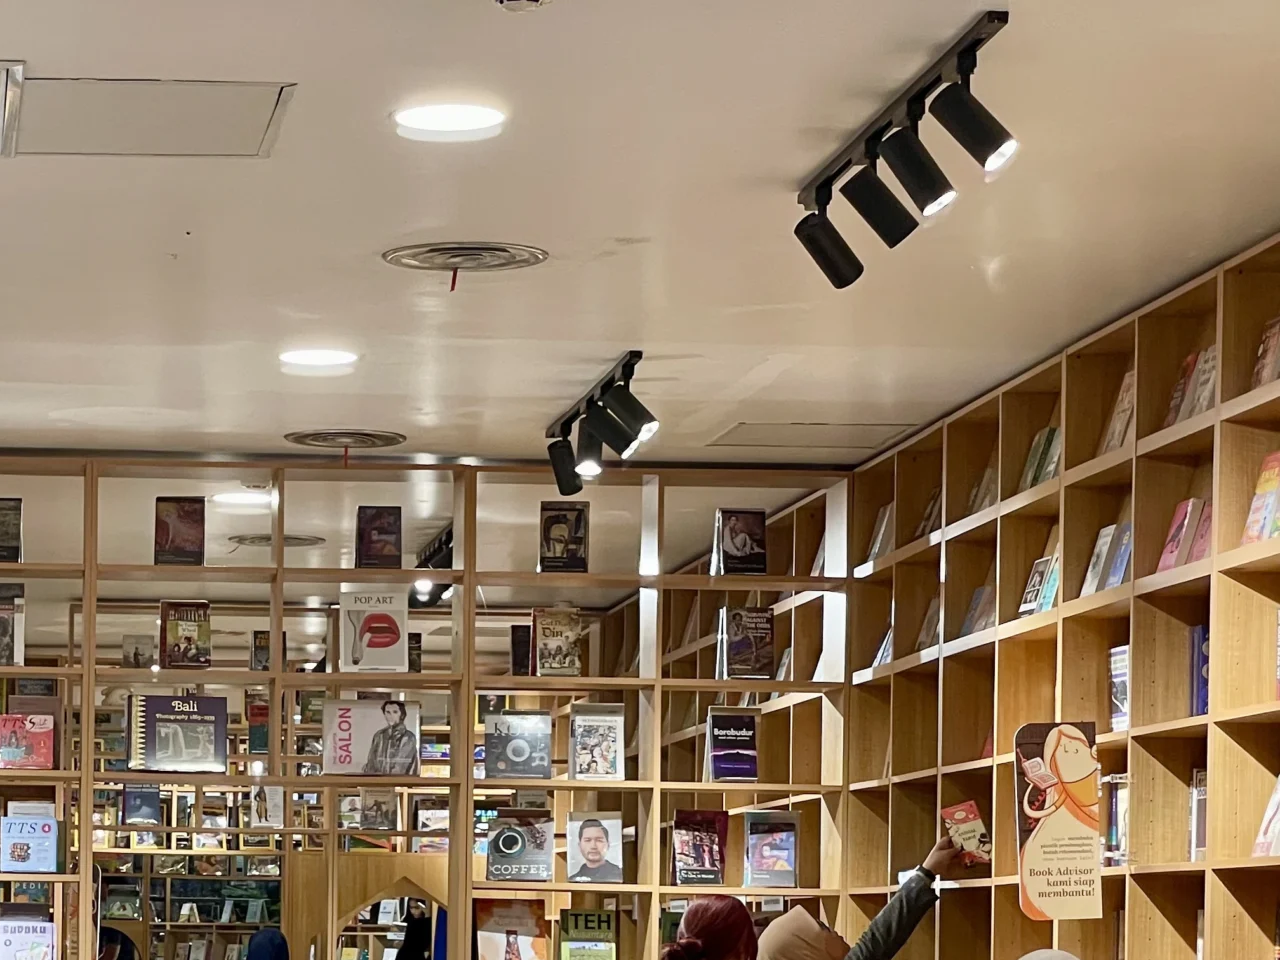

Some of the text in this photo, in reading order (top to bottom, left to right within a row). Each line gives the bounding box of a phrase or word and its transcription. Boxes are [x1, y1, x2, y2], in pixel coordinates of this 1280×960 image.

[353, 596, 395, 605] POP ART
[171, 700, 198, 712] Bali
[1, 718, 28, 729] TTS
[337, 707, 353, 765] SALON
[713, 727, 754, 737] Borobudur
[6, 822, 38, 834] TTS
[492, 864, 547, 875] COFFEE
[1029, 866, 1095, 877] Book Advisor
[1046, 876, 1095, 888] kami siap
[1038, 888, 1095, 898] membantu!
[570, 913, 612, 930] TEH
[2, 925, 47, 934] SUDOKU
